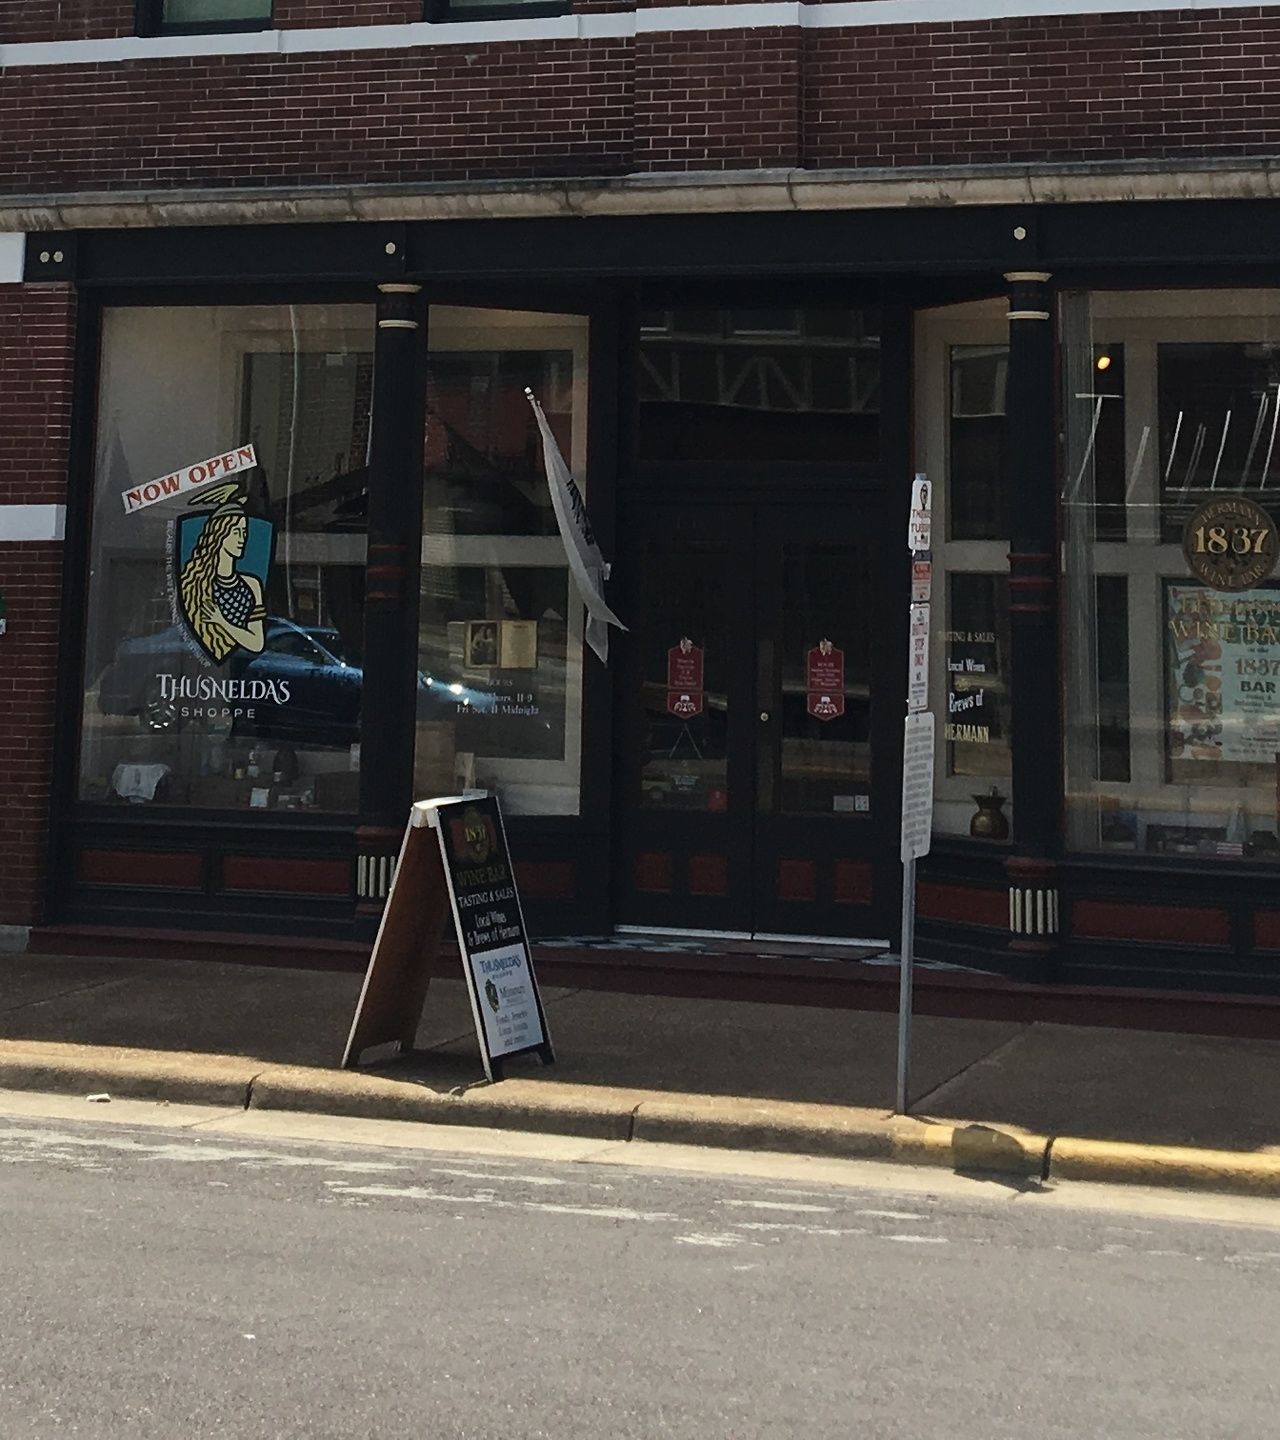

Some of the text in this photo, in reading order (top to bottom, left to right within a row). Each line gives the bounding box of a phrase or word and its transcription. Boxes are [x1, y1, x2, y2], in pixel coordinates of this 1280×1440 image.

[126, 446, 254, 510] NOW OPEN
[1195, 526, 1271, 554] 1837
[1170, 620, 1236, 641] WINE
[156, 673, 292, 706] THUSNELDA'S
[1240, 681, 1276, 694] BAR
[180, 705, 256, 720] SHOPPE
[943, 722, 990, 744] HERMANN
[458, 892, 488, 909] TASTING
